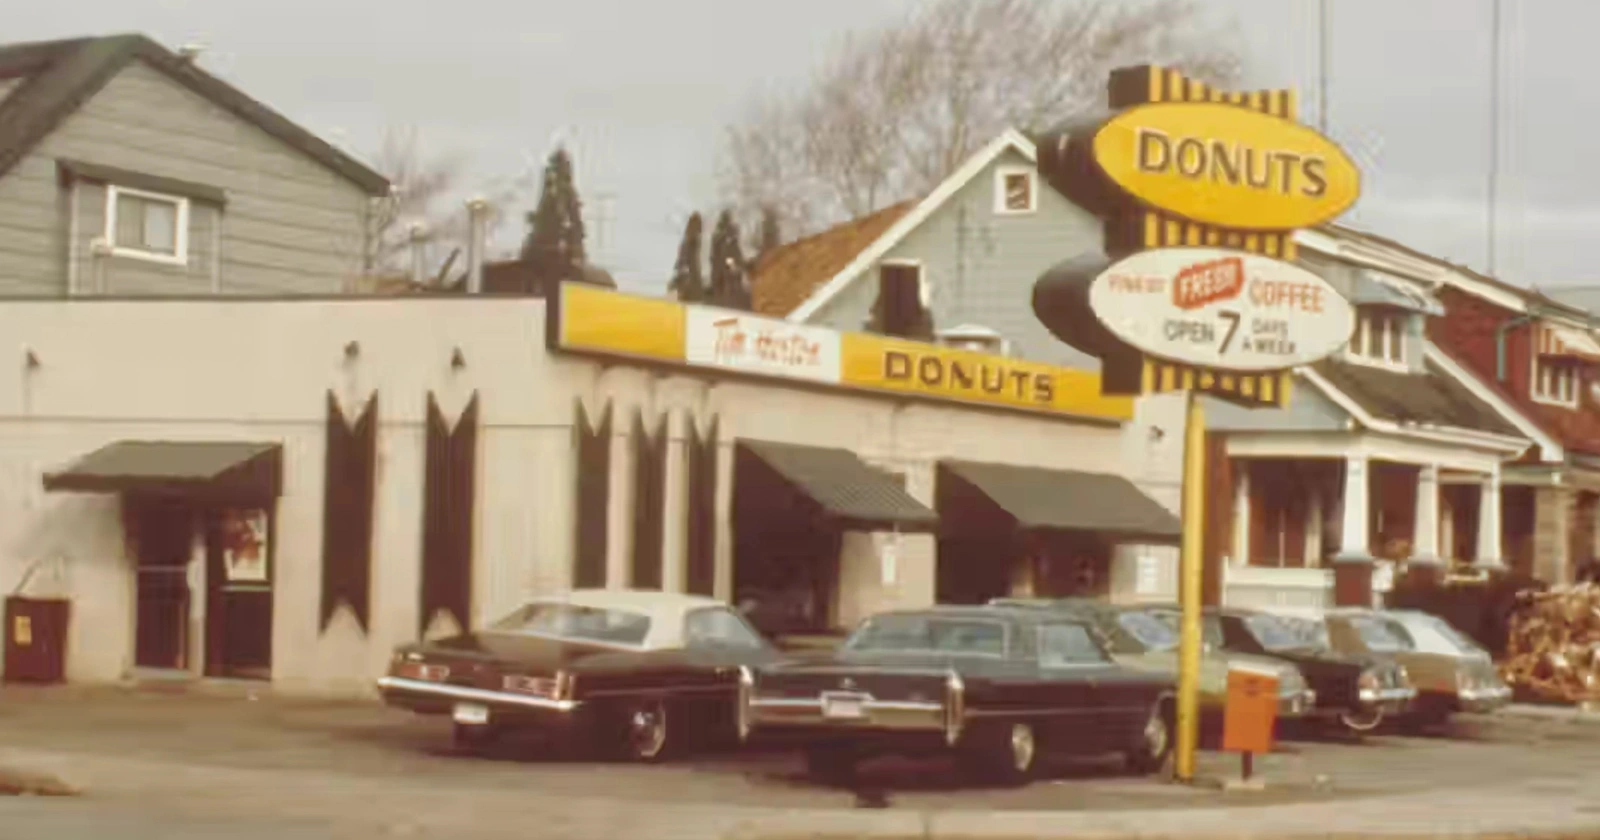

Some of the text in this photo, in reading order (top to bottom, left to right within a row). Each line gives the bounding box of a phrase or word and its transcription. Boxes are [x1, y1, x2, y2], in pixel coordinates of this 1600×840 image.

[1136, 128, 1328, 197] DONUTS
[1249, 279, 1325, 313] COFFEE
[1163, 310, 1241, 354] OPEN 7
[883, 351, 1054, 402] DONUTS
